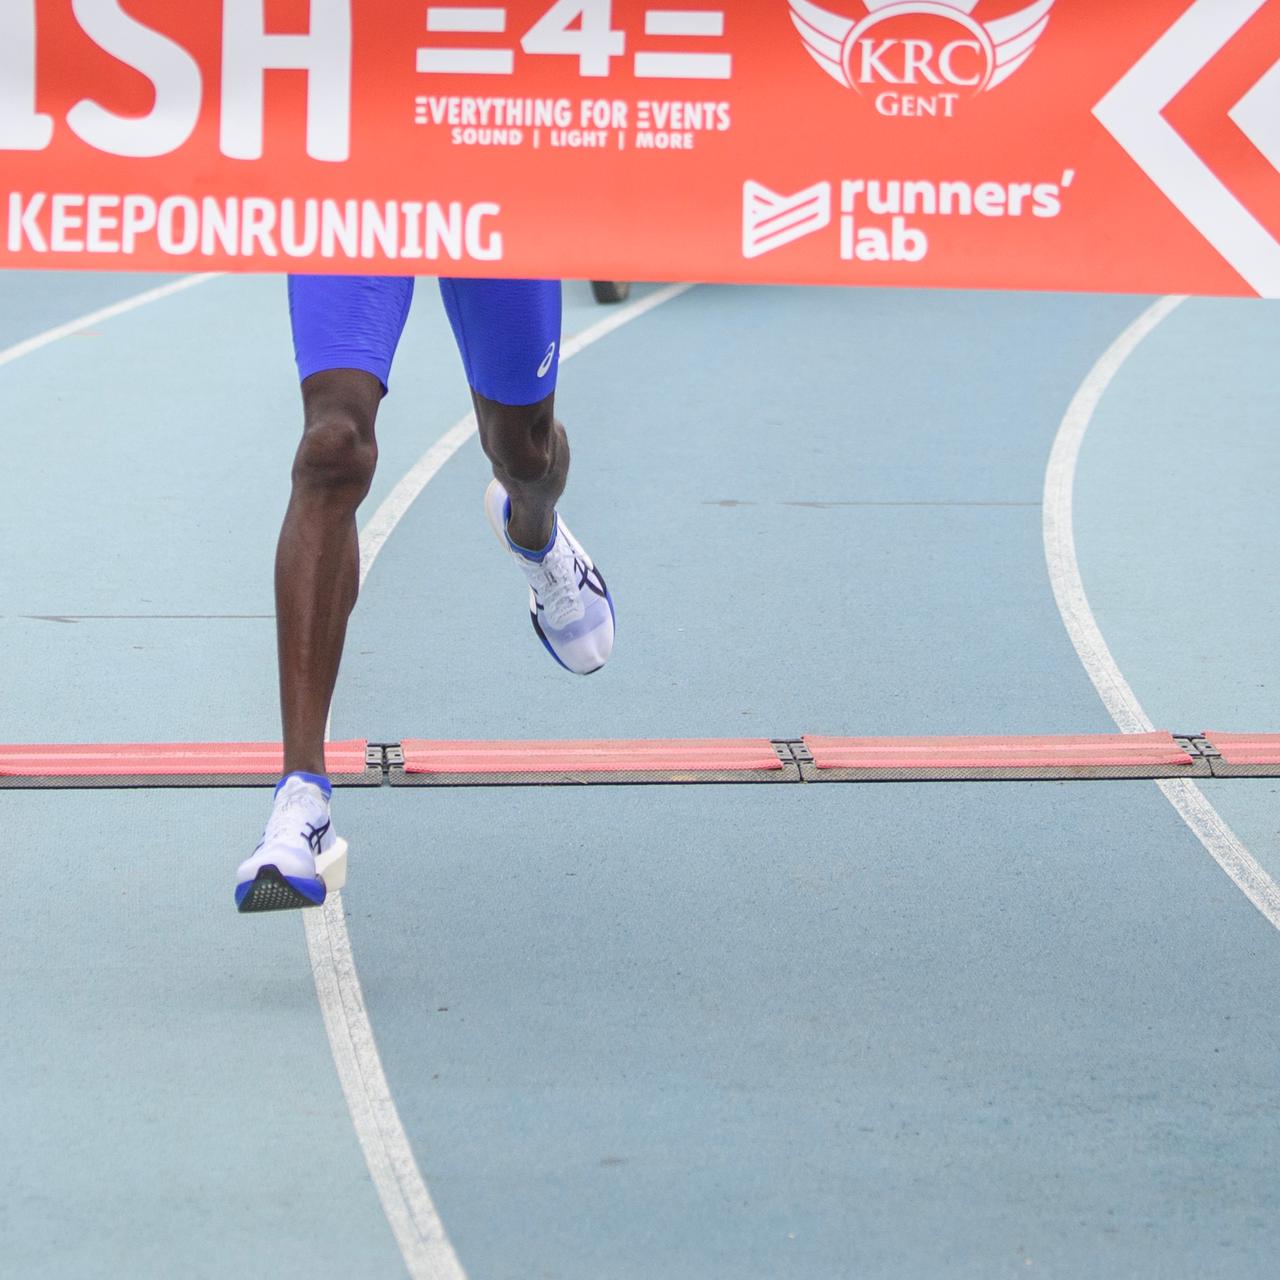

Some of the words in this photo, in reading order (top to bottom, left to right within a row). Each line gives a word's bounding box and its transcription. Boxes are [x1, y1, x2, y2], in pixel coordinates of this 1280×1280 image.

[858, 38, 982, 87] KRC
[414, 95, 573, 129] EVERYTHING
[580, 98, 628, 129] FOR
[636, 100, 731, 132] EVENTS
[451, 128, 523, 147] SOUND
[550, 129, 608, 149] LIGHT
[635, 130, 694, 150] MORE
[840, 218, 928, 262] lab
